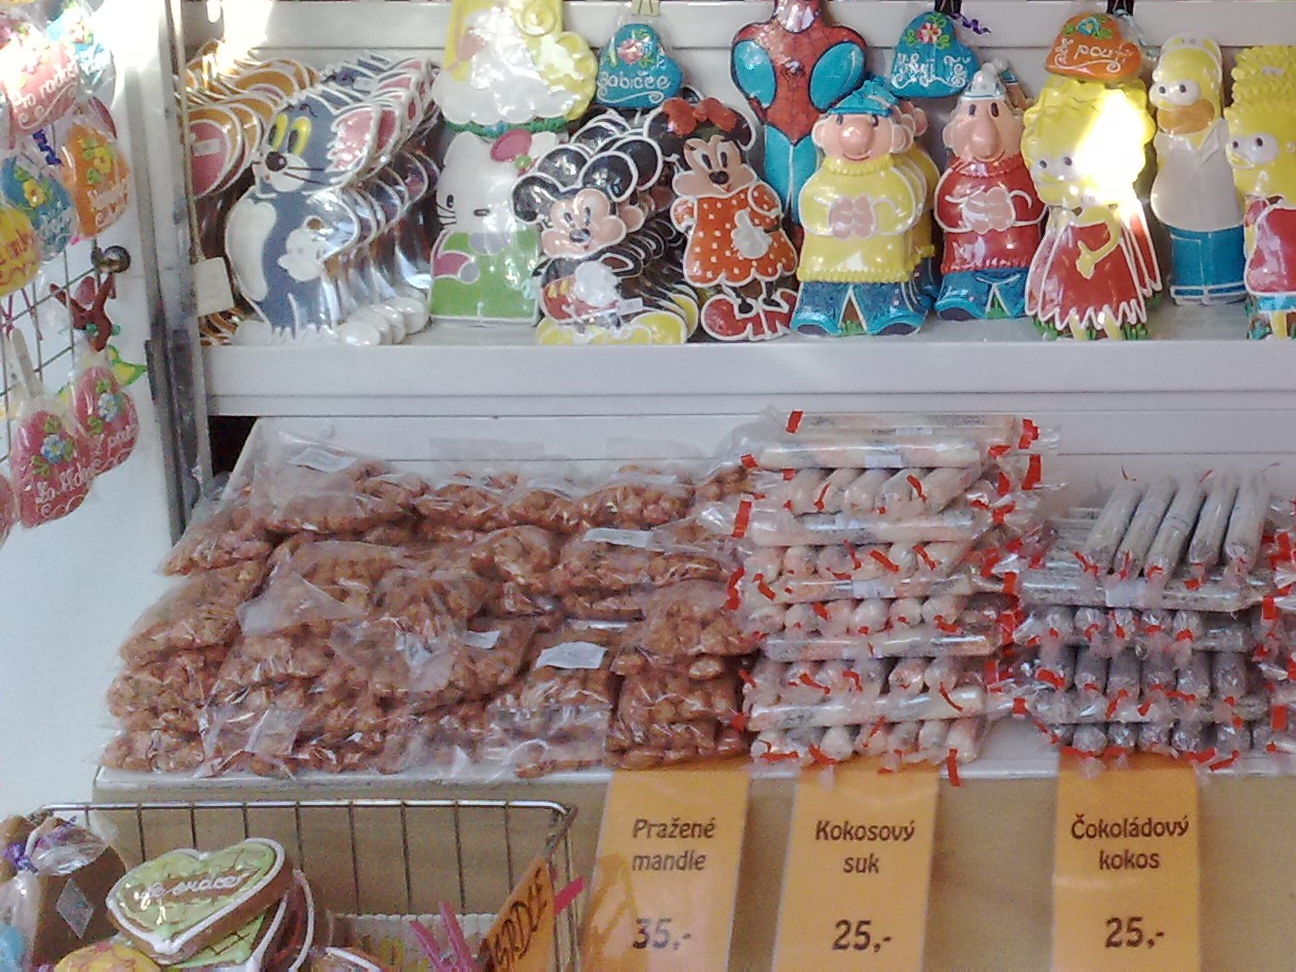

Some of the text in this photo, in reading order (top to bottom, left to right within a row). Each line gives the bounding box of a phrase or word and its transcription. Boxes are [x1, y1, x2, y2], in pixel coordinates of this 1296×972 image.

[632, 817, 716, 840] Pražené
[815, 819, 915, 843] Kokosový
[1070, 814, 1189, 840] Čokoládový
[632, 850, 707, 872] mandle
[843, 853, 880, 874] suk
[1099, 849, 1161, 870] kokos
[633, 918, 692, 950] 35,-
[832, 920, 892, 953] 25,-
[1105, 917, 1165, 949] 25,-
